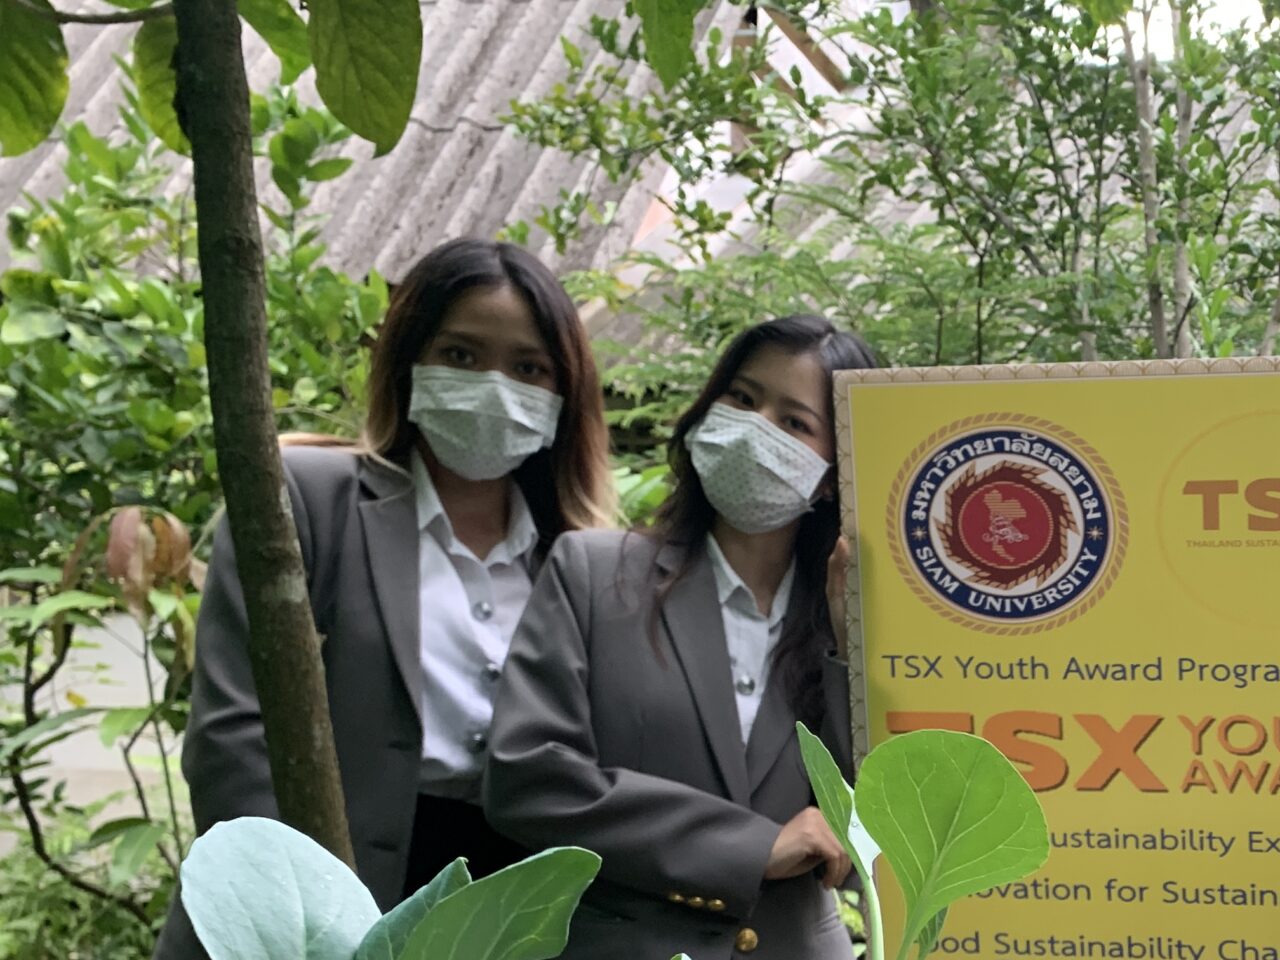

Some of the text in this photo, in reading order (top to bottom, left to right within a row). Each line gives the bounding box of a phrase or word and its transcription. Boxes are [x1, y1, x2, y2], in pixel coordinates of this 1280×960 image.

[910, 431, 1102, 521] มหาวิทยาลัยสยาม
[1185, 539, 1242, 548] THAILAND
[915, 546, 1098, 613] SIAM UNIVERSITY
[881, 654, 943, 680] TSX
[955, 655, 1050, 681] Youth
[1063, 656, 1163, 682] Award
[1050, 828, 1236, 858] ustainability
[1105, 878, 1150, 903] for
